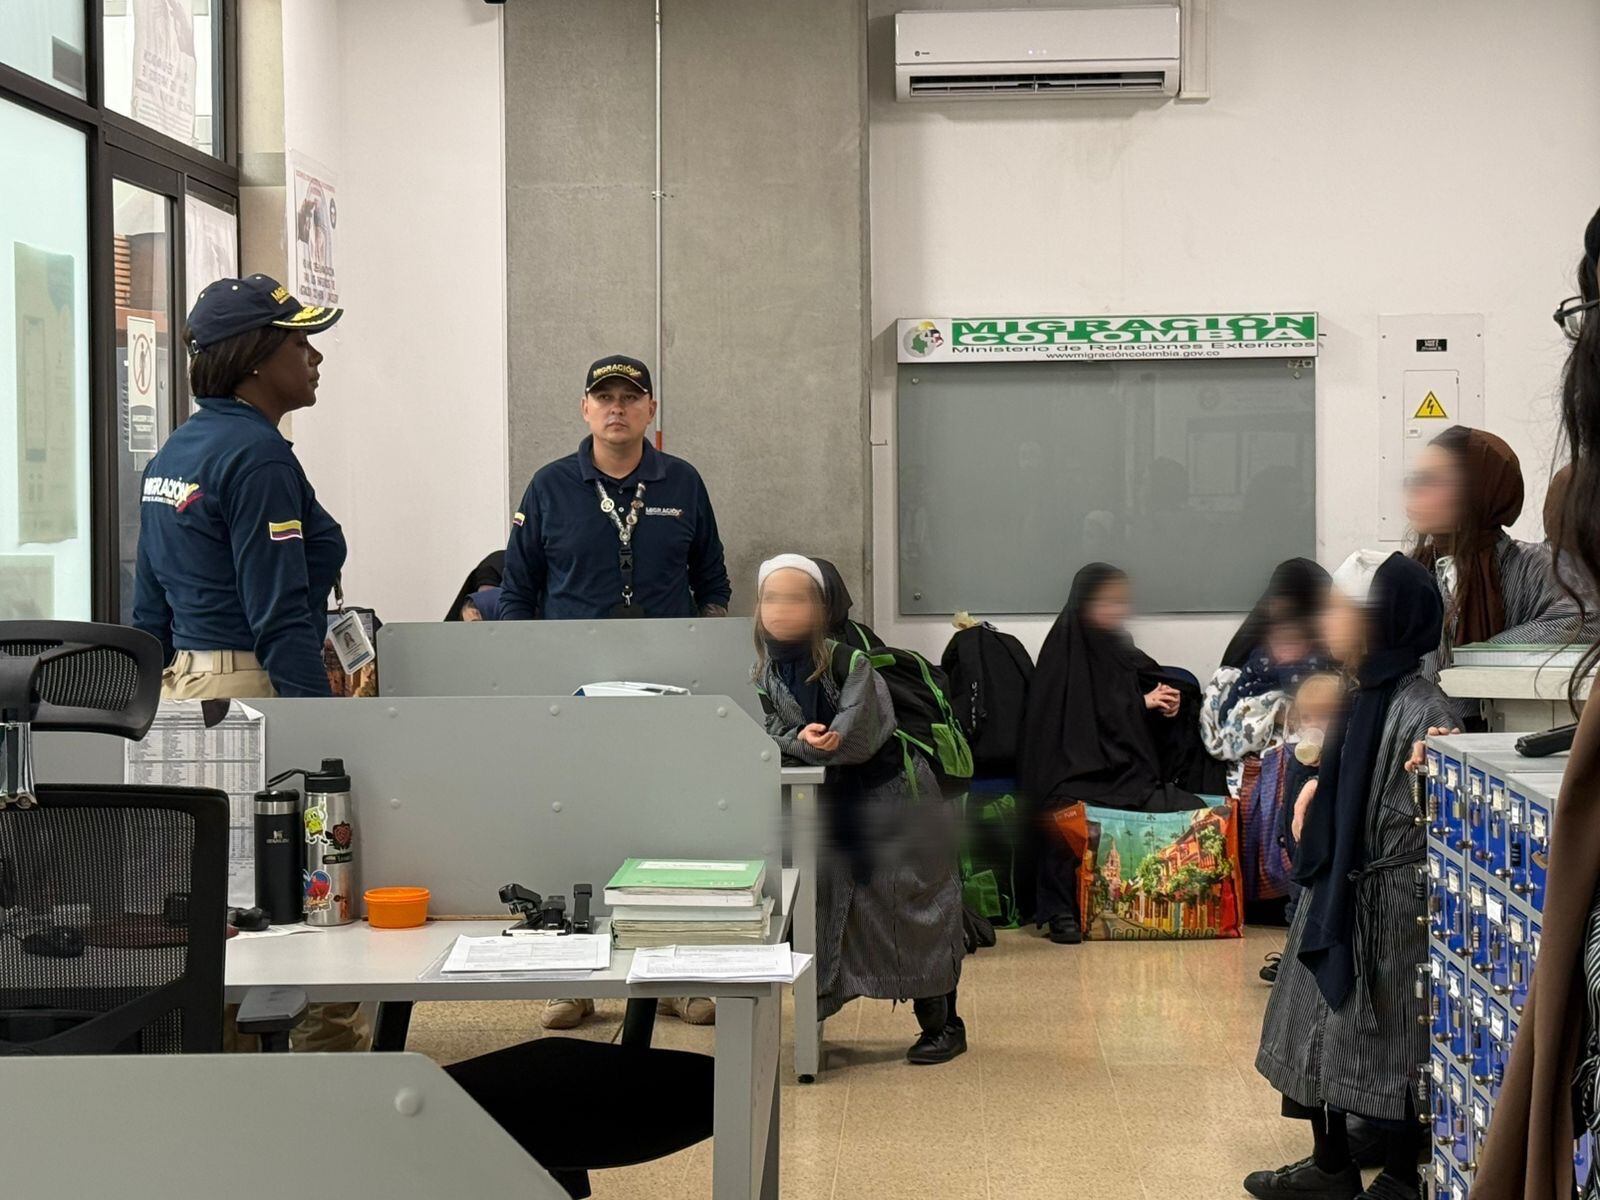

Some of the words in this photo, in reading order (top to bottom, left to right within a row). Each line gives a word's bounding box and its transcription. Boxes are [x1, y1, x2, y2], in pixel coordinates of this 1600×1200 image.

[952, 314, 1316, 334] MIGRACIÓN
[958, 328, 1308, 344] COLOMBIA
[952, 345, 1049, 353] Ministerio
[1057, 344, 1081, 352] de
[1089, 343, 1203, 351] Relaciones
[1211, 341, 1316, 349] Exteriores
